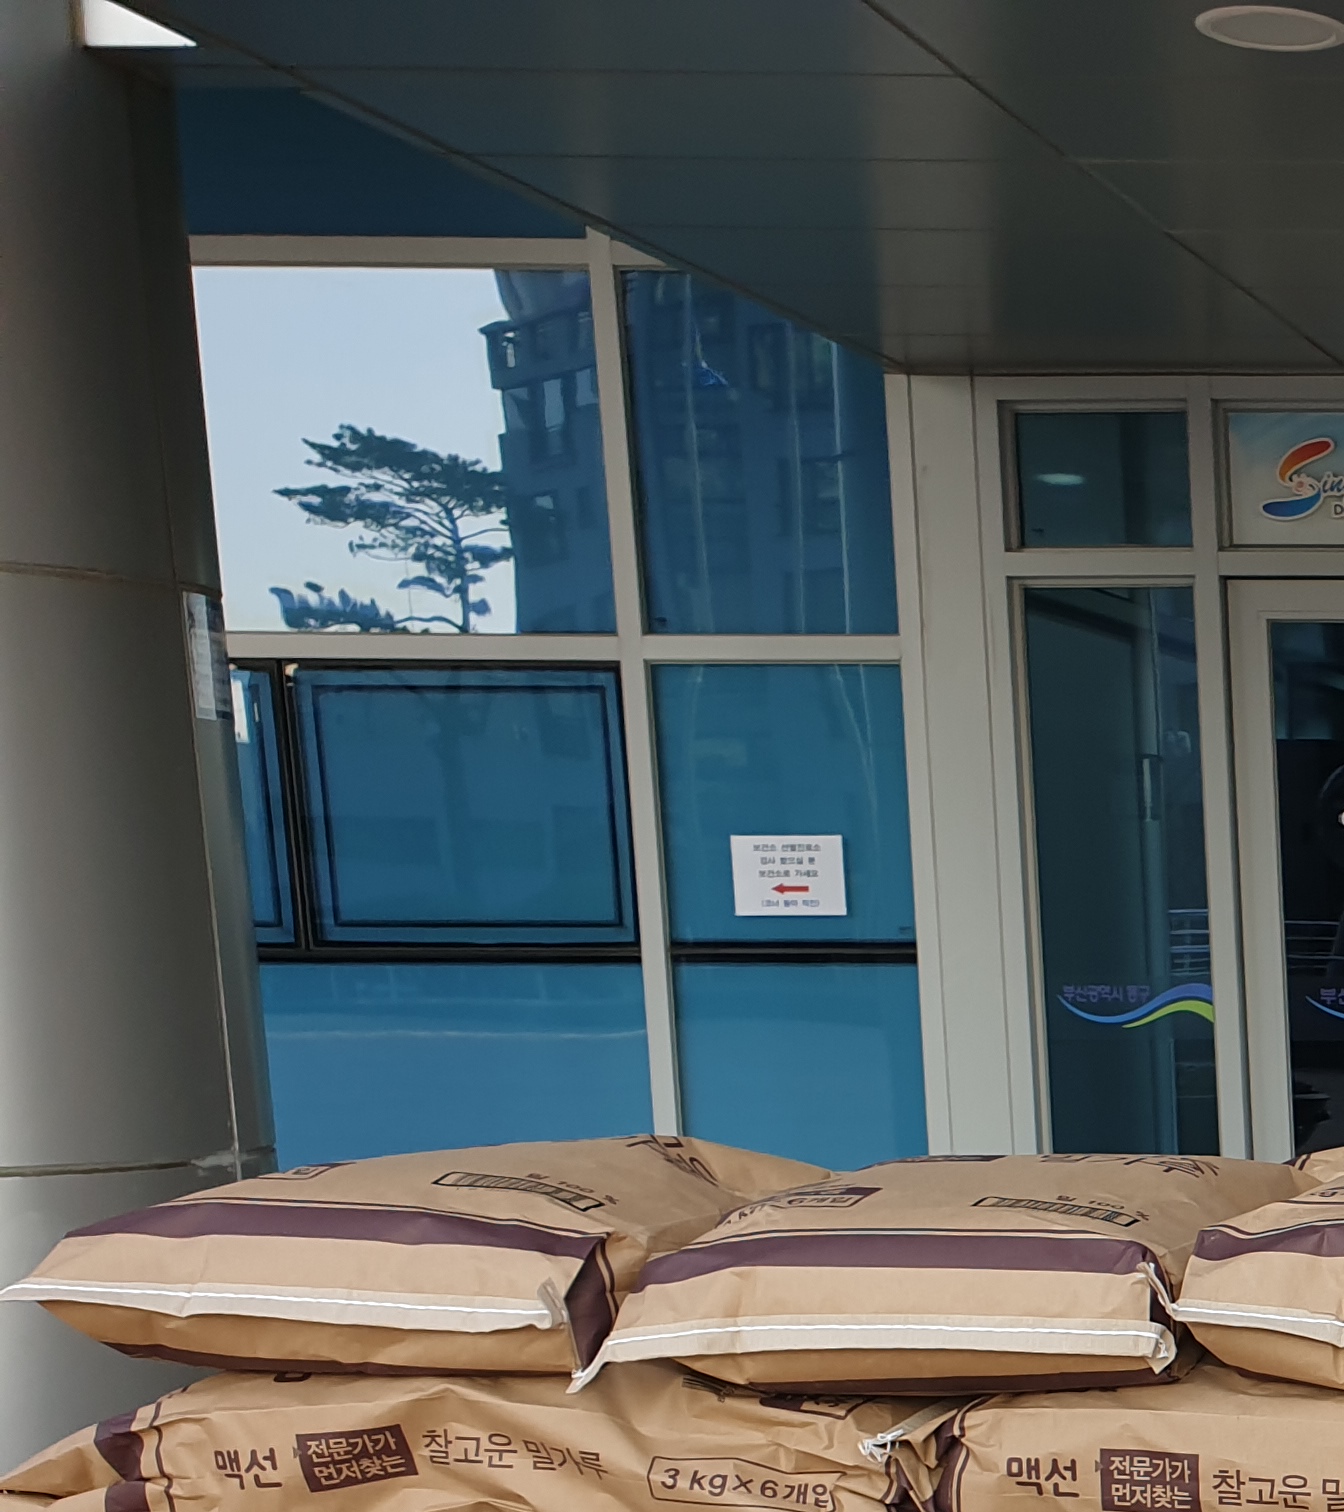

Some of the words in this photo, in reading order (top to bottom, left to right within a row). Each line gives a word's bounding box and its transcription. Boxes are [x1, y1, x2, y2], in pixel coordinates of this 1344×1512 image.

[305, 1433, 398, 1463] 전문가가
[420, 1428, 519, 1470] 찰고운
[213, 1446, 283, 1492] 맥선
[311, 1456, 407, 1488] 먼저찾는
[1005, 1456, 1080, 1499] 맥선
[1109, 1454, 1191, 1482] 전문가가
[1112, 1482, 1193, 1511] 먼저찾는
[1210, 1468, 1313, 1511] 찰고운
